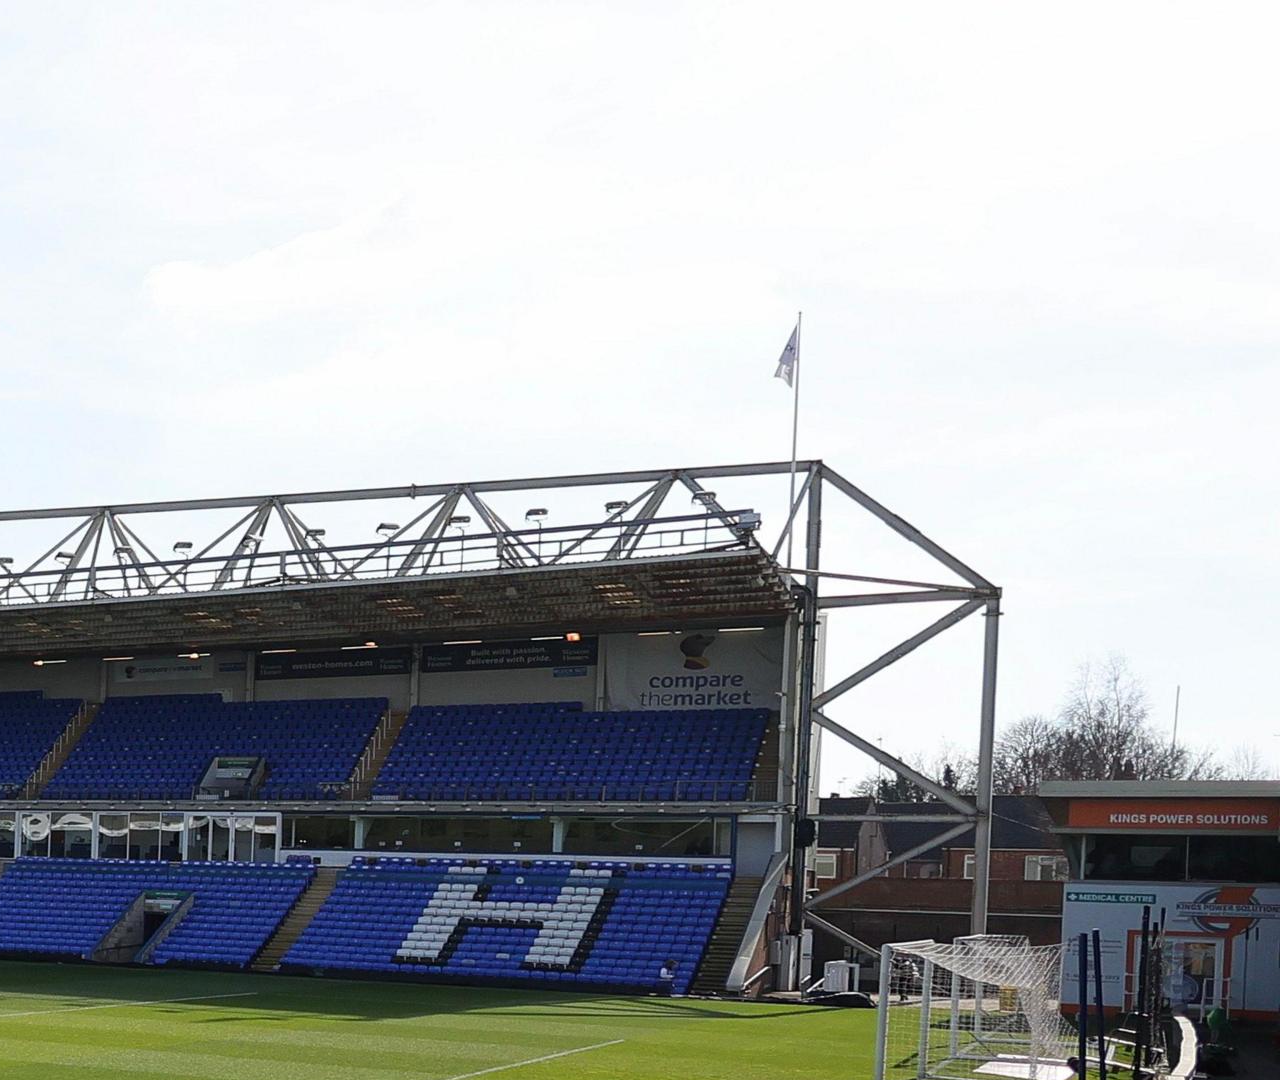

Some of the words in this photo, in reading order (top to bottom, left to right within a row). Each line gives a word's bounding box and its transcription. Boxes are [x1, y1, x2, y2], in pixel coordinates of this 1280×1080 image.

[471, 649, 490, 657] Built
[493, 648, 511, 656] with
[292, 659, 373, 671] weston-homes.com
[466, 657, 504, 665] delivered
[506, 656, 525, 664] with
[527, 655, 552, 664] pride.
[649, 674, 744, 691] compare
[639, 690, 752, 706] themarket
[1109, 813, 1146, 824] KINGS
[1149, 814, 1194, 824] POWER
[1196, 815, 1269, 825] SOLUTIONS
[1078, 894, 1117, 903] MEDICAL
[1119, 895, 1154, 903] CENTRE
